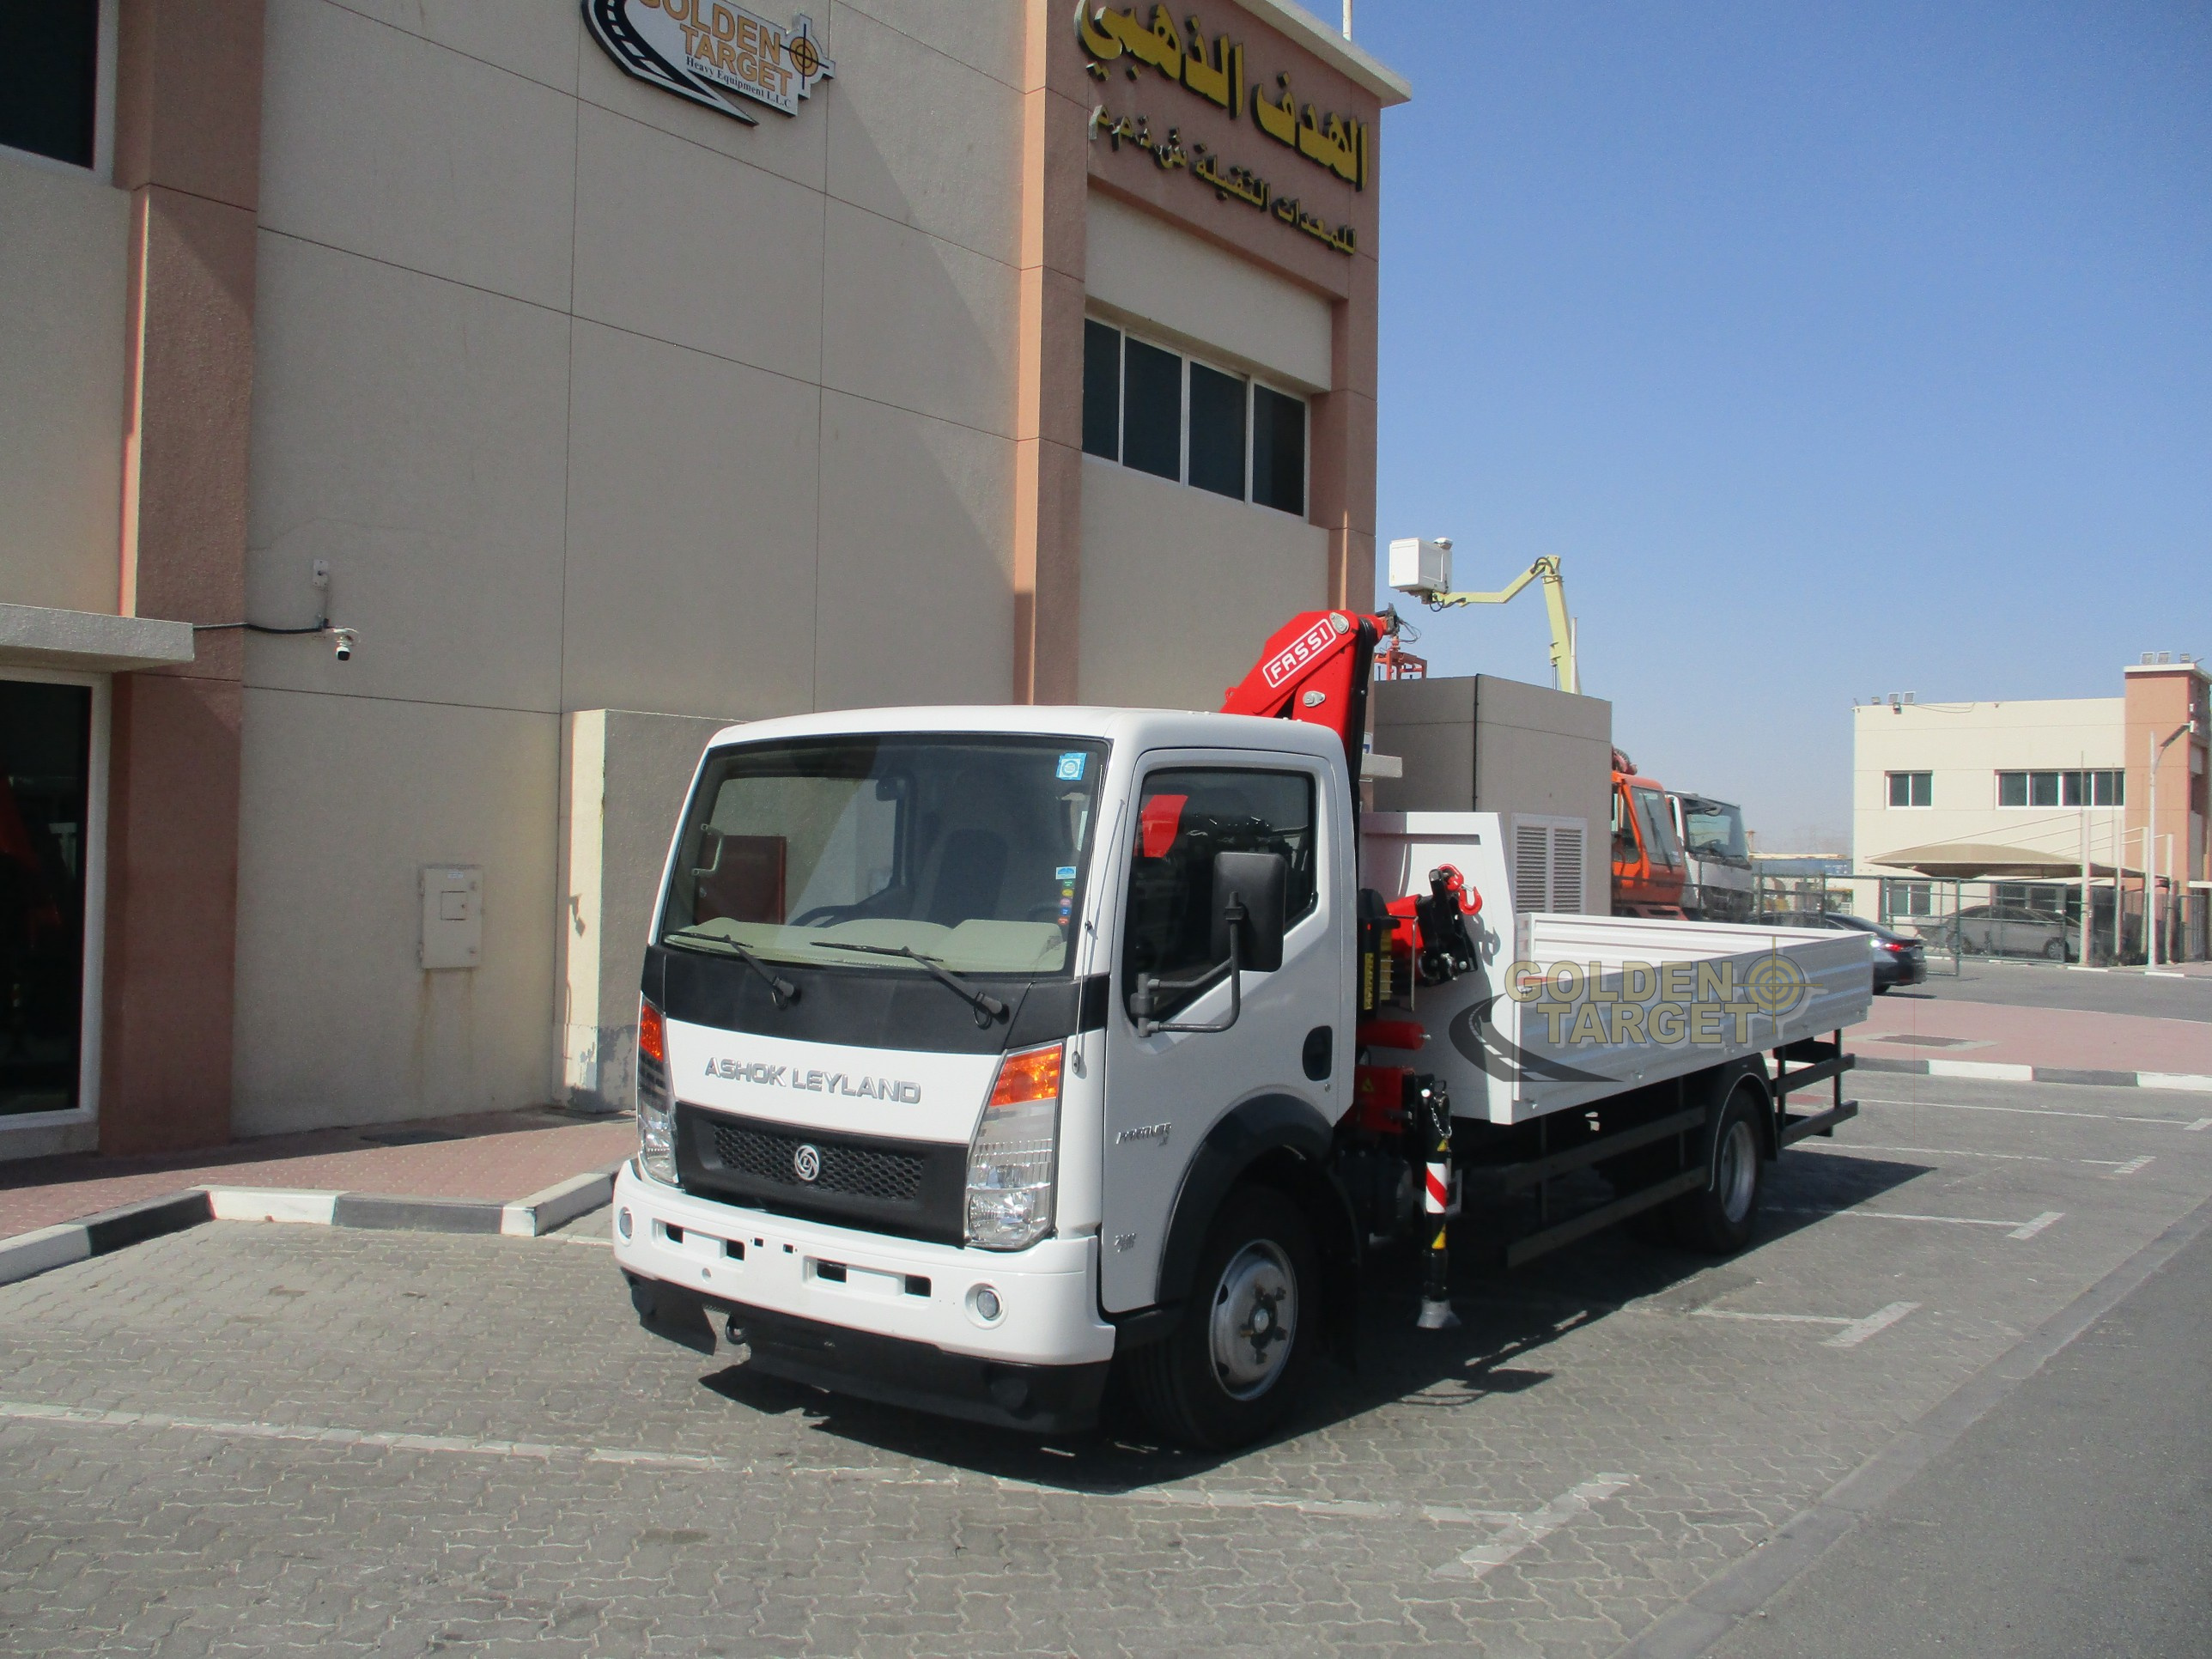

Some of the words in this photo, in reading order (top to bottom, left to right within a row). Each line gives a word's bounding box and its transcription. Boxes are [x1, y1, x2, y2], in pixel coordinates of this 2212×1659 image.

[640, 0, 781, 65] OLDEN
[681, 24, 793, 96] TARGET
[1074, 0, 1243, 120] الذهبي
[686, 56, 714, 78] Heavy
[717, 70, 764, 97] Equipment
[1250, 71, 1369, 191] الهدف
[1189, 143, 1271, 212] الثقيلة
[1270, 197, 1357, 255] للمعدات
[1270, 627, 1328, 680] FASSI
[705, 1056, 787, 1087] ASHOK
[792, 1067, 921, 1104] LEYLAND
